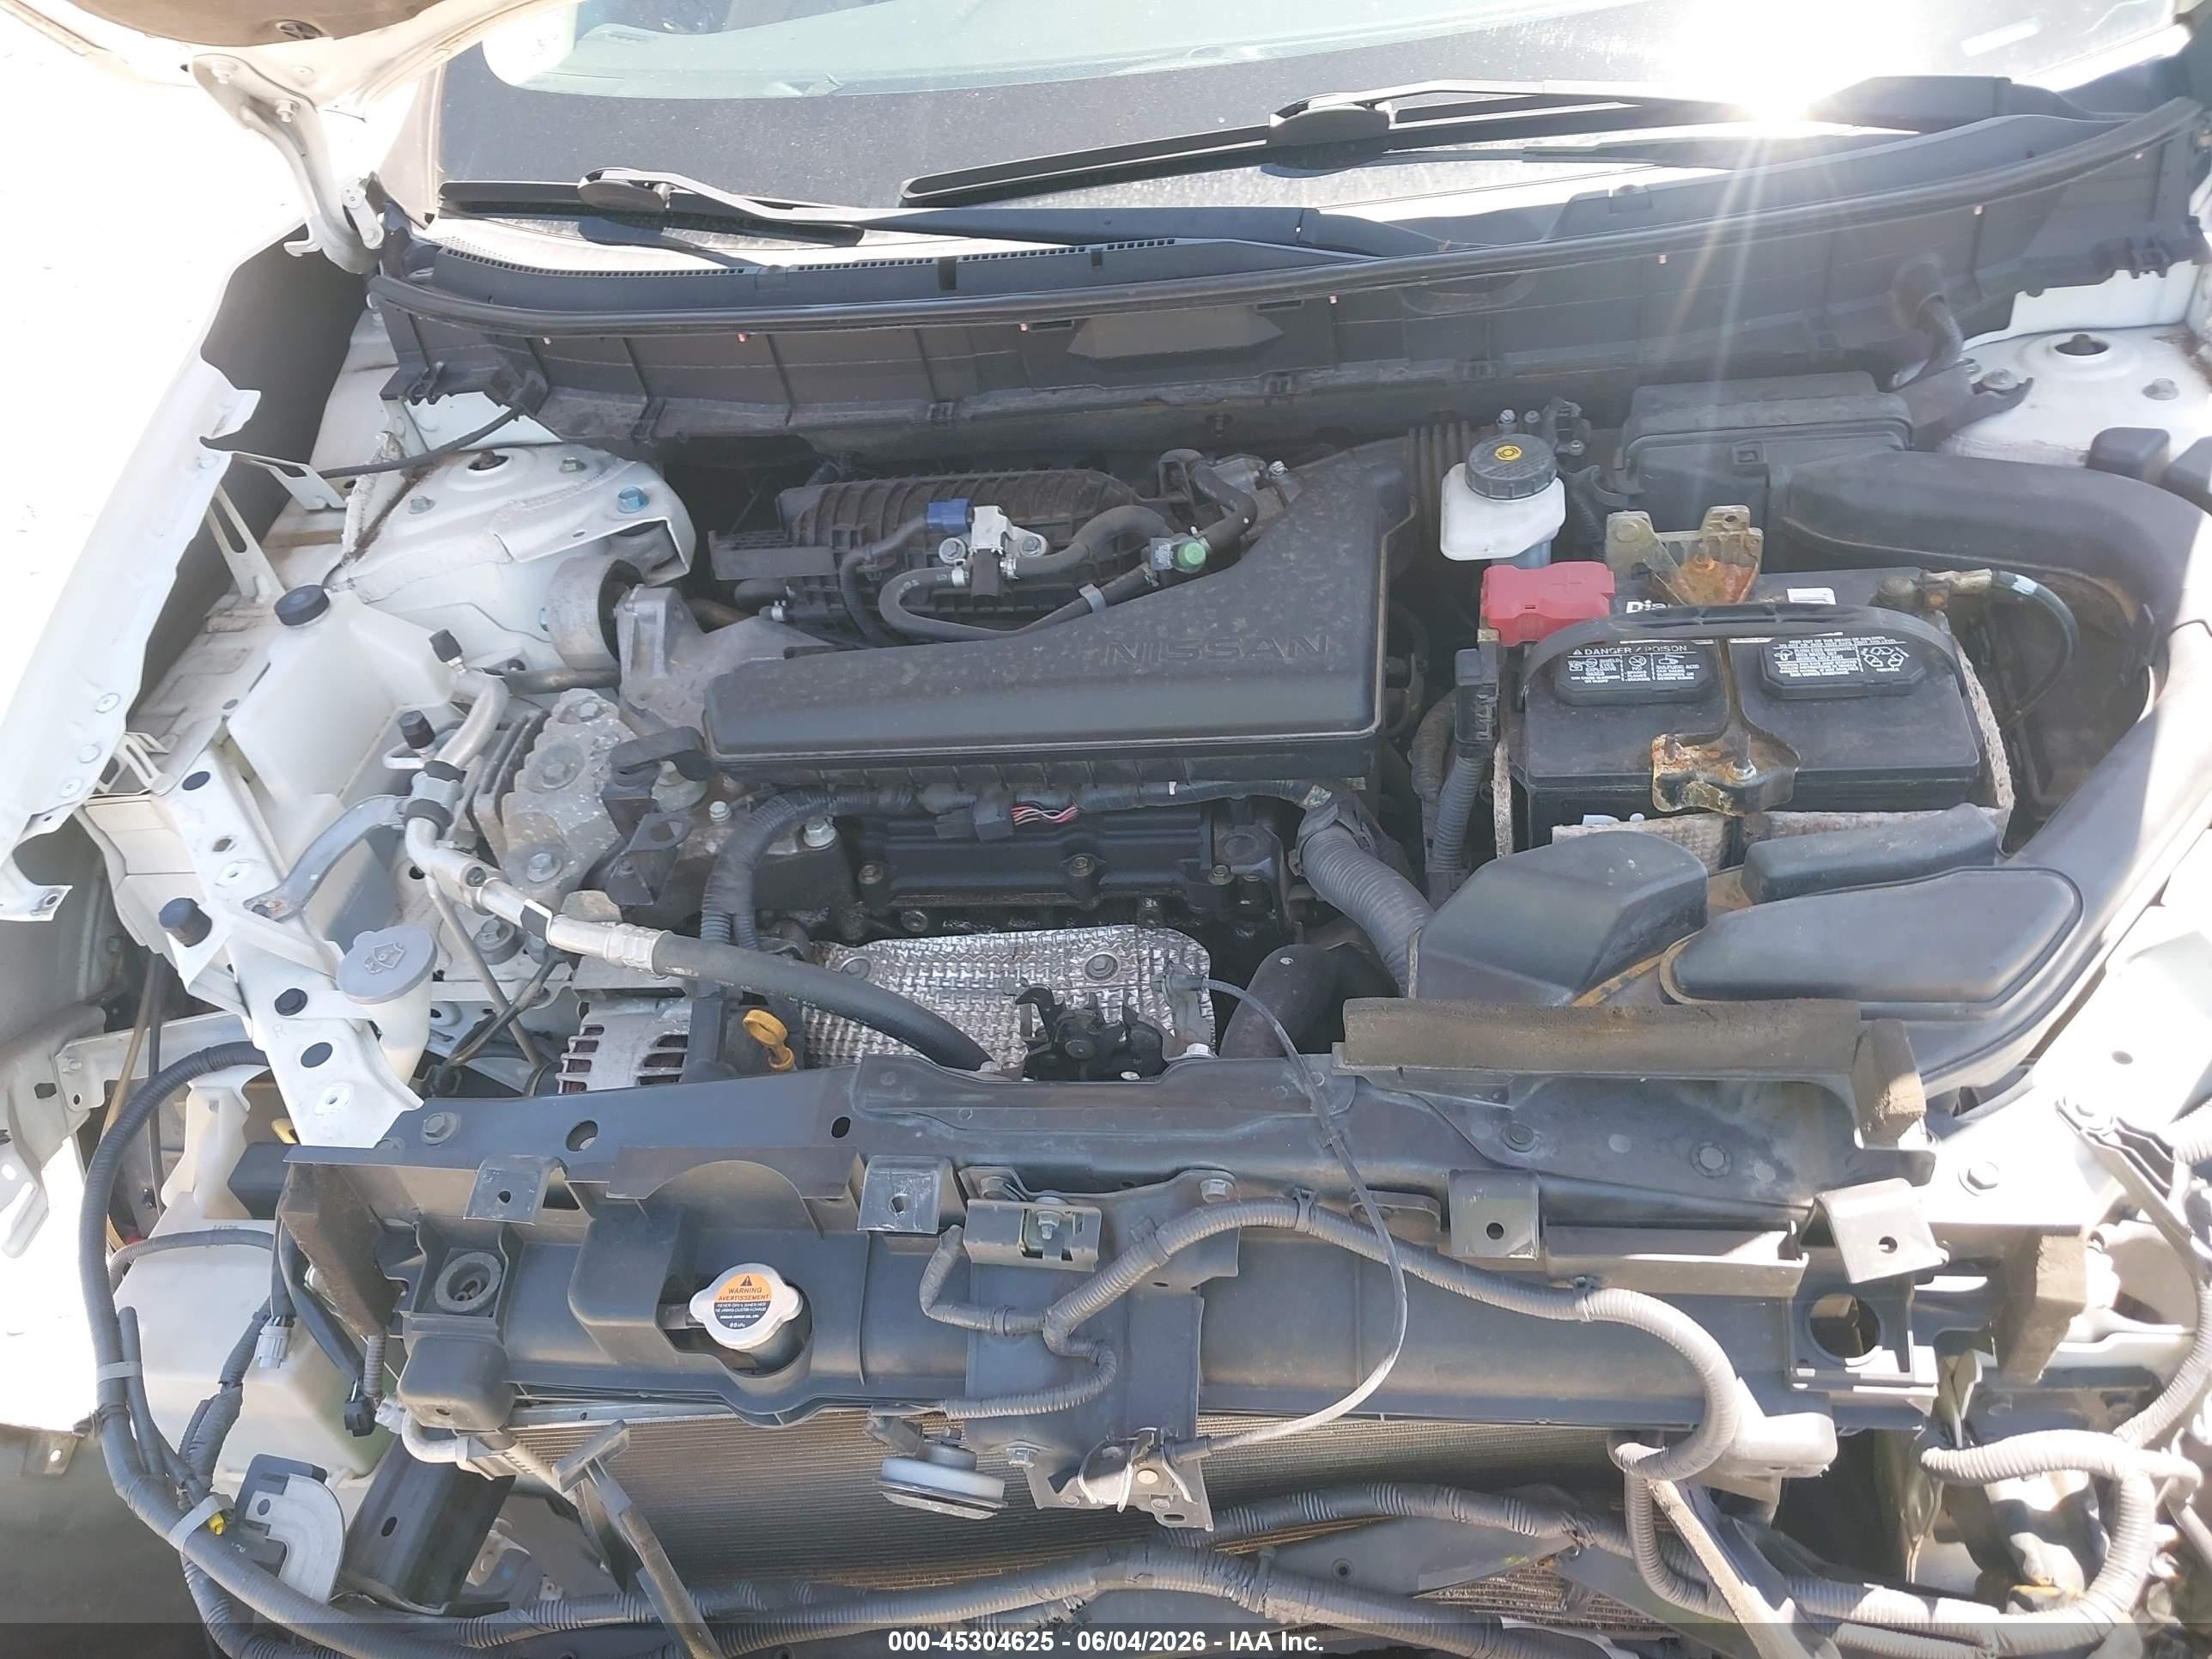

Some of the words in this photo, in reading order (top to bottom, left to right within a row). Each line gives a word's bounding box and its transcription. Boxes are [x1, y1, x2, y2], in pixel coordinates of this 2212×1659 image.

[1099, 635, 1329, 666] NISSAN
[1583, 647, 1632, 656] DANGER
[1644, 645, 1688, 653] POISON
[728, 1286, 763, 1295] WARNING
